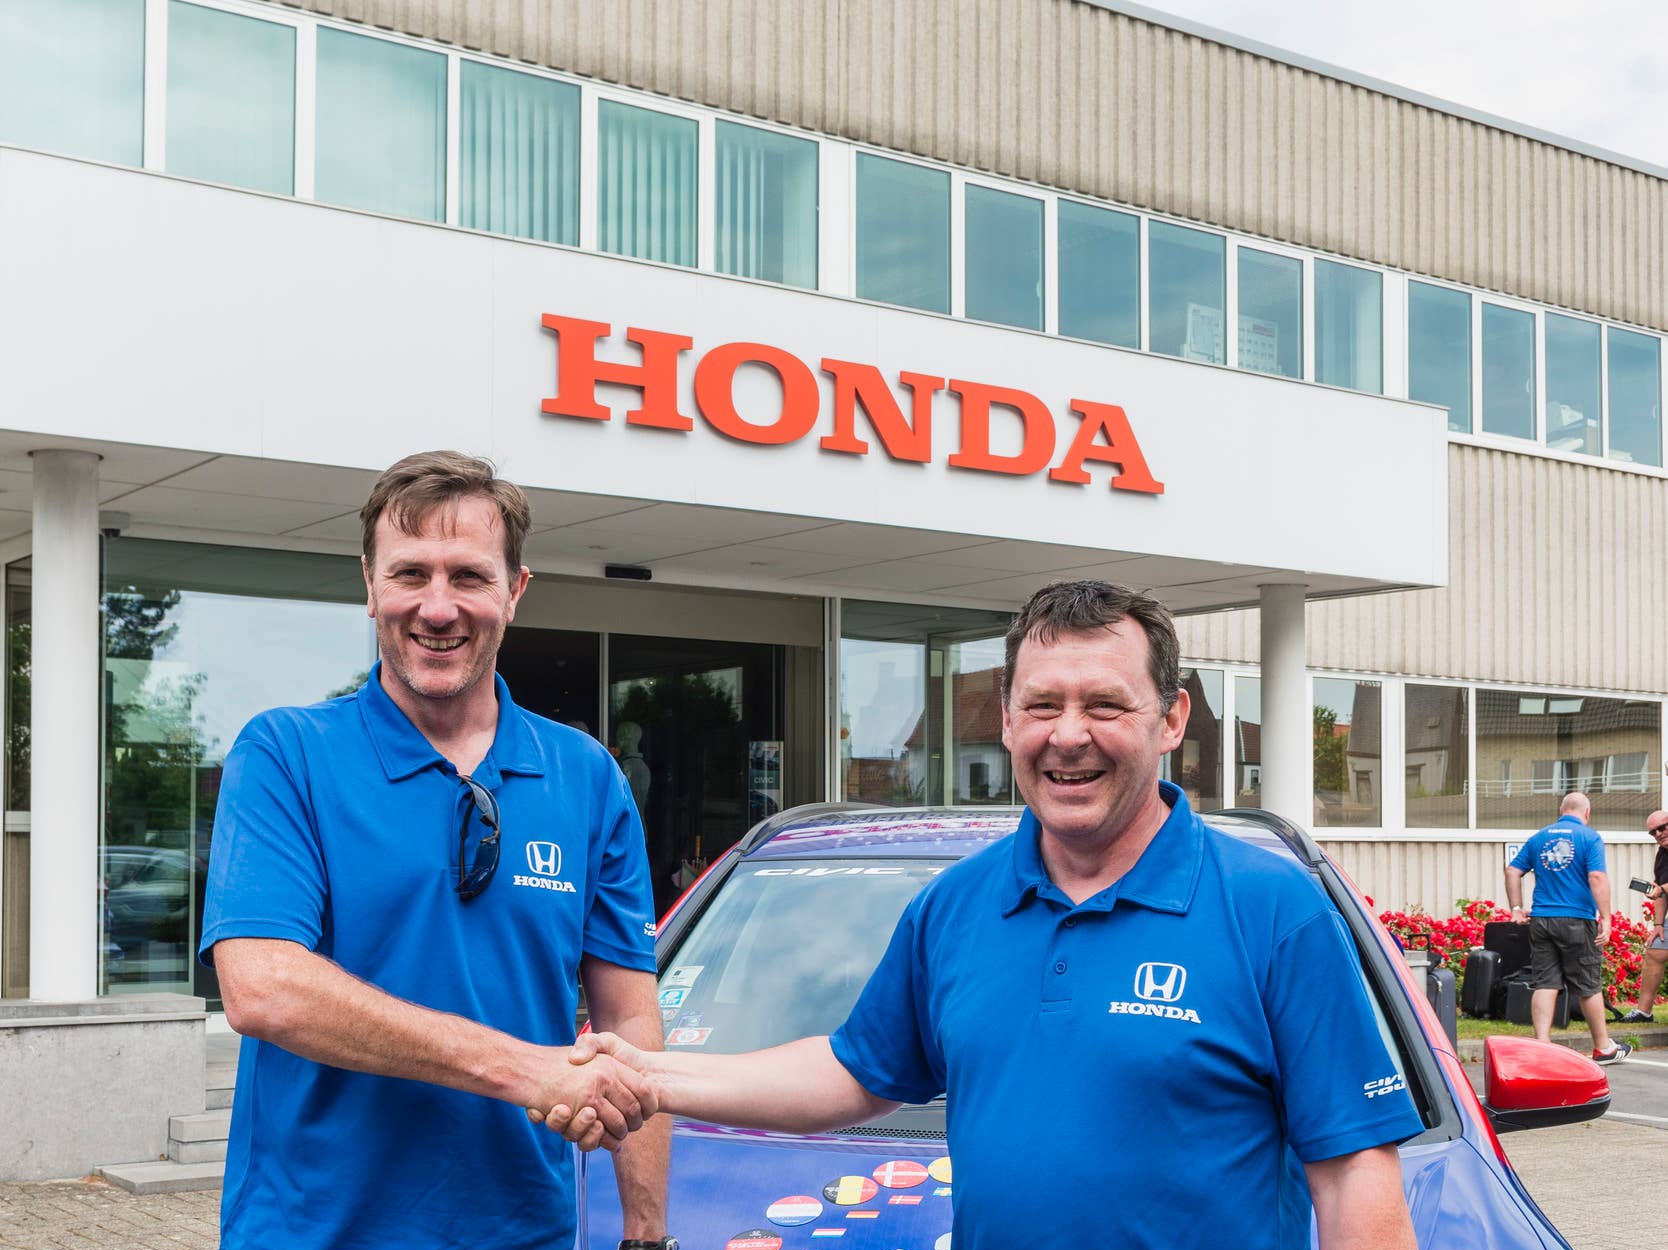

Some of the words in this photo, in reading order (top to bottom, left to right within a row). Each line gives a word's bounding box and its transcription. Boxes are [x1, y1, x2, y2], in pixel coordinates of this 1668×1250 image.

[541, 313, 1164, 495] HONDA
[754, 867, 904, 876] CIVIC
[513, 875, 576, 892] HONDA
[1109, 1002, 1201, 1023] HONDA
